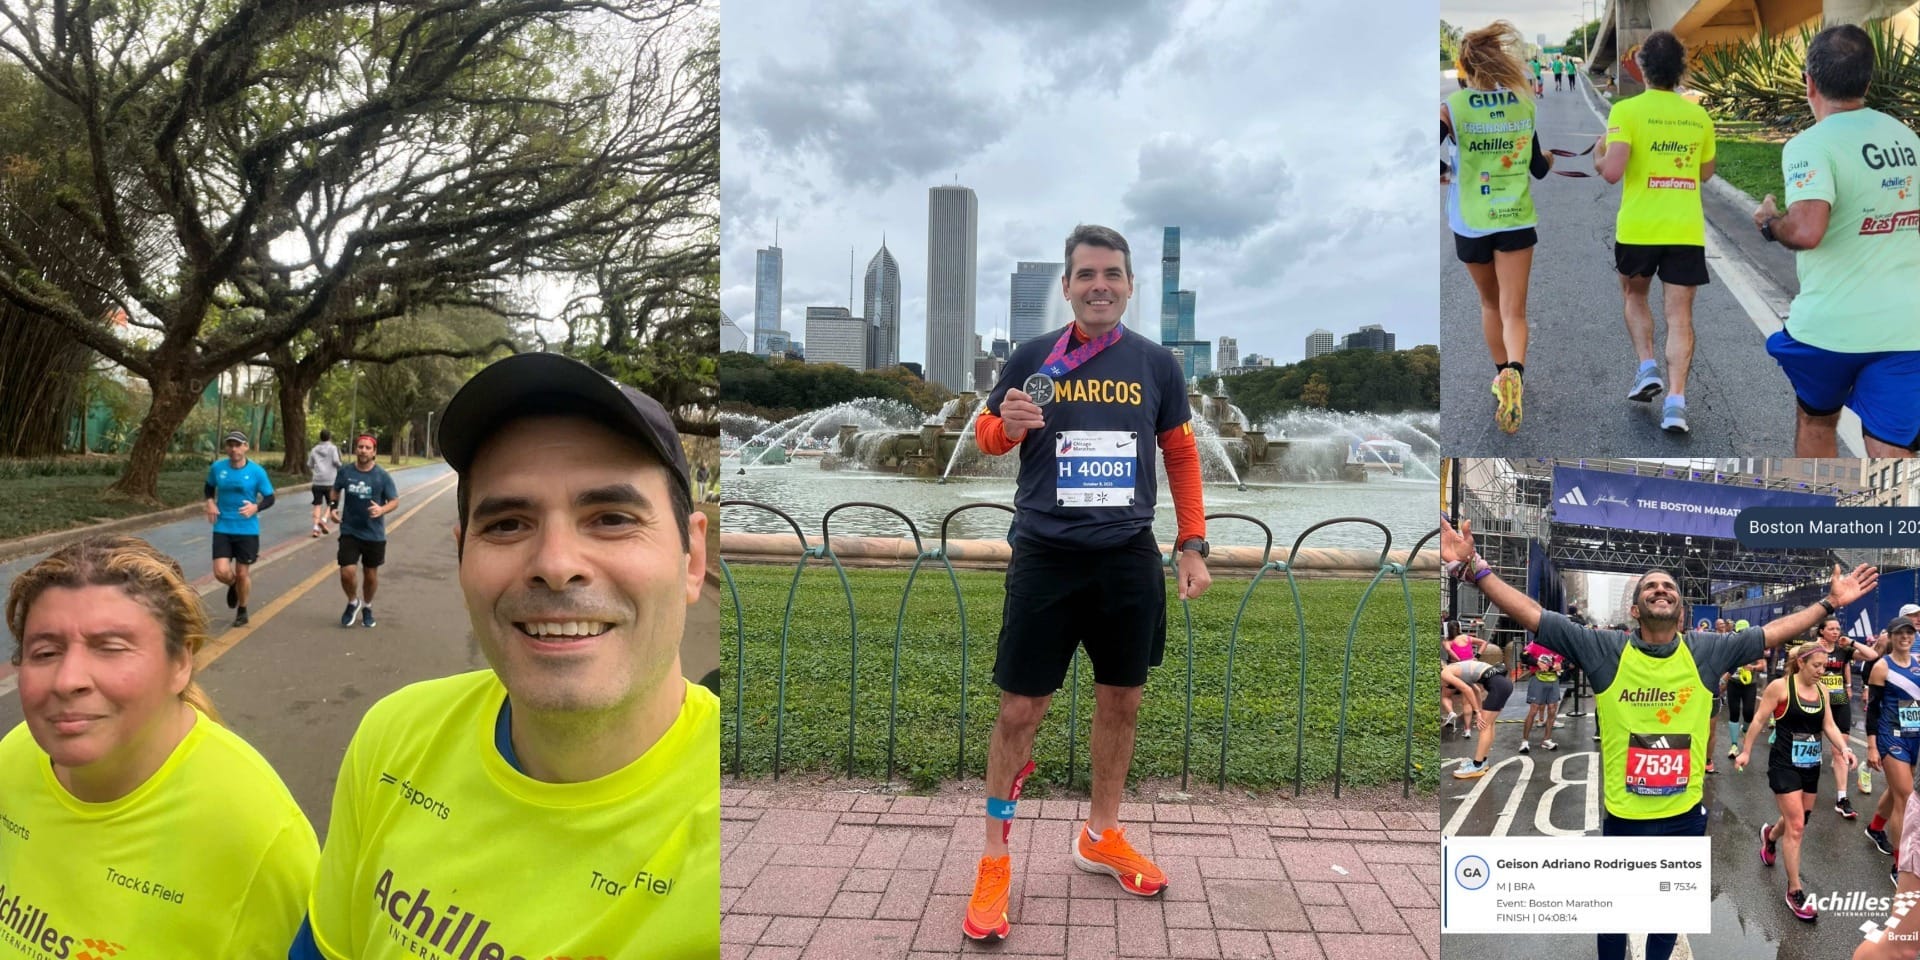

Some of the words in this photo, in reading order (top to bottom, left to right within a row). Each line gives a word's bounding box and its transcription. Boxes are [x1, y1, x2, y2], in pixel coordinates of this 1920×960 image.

[1469, 92, 1519, 109] GUIA
[1490, 110, 1505, 119] em
[1469, 138, 1514, 152] Achilles
[1650, 141, 1688, 153] Achilles
[1861, 141, 1918, 170] Guia
[1055, 379, 1142, 406] MARCOS
[1059, 461, 1072, 477] H
[1078, 461, 1132, 477] 40081
[1637, 499, 1658, 510] THE
[1660, 502, 1702, 514] BOSTON
[1704, 506, 1741, 517] MARAT
[1618, 687, 1676, 702] Achilles
[1634, 753, 1683, 775] 7534
[106, 867, 141, 892] Track
[151, 883, 185, 905] Field
[634, 871, 676, 896] Fiel
[374, 868, 527, 960] Achille
